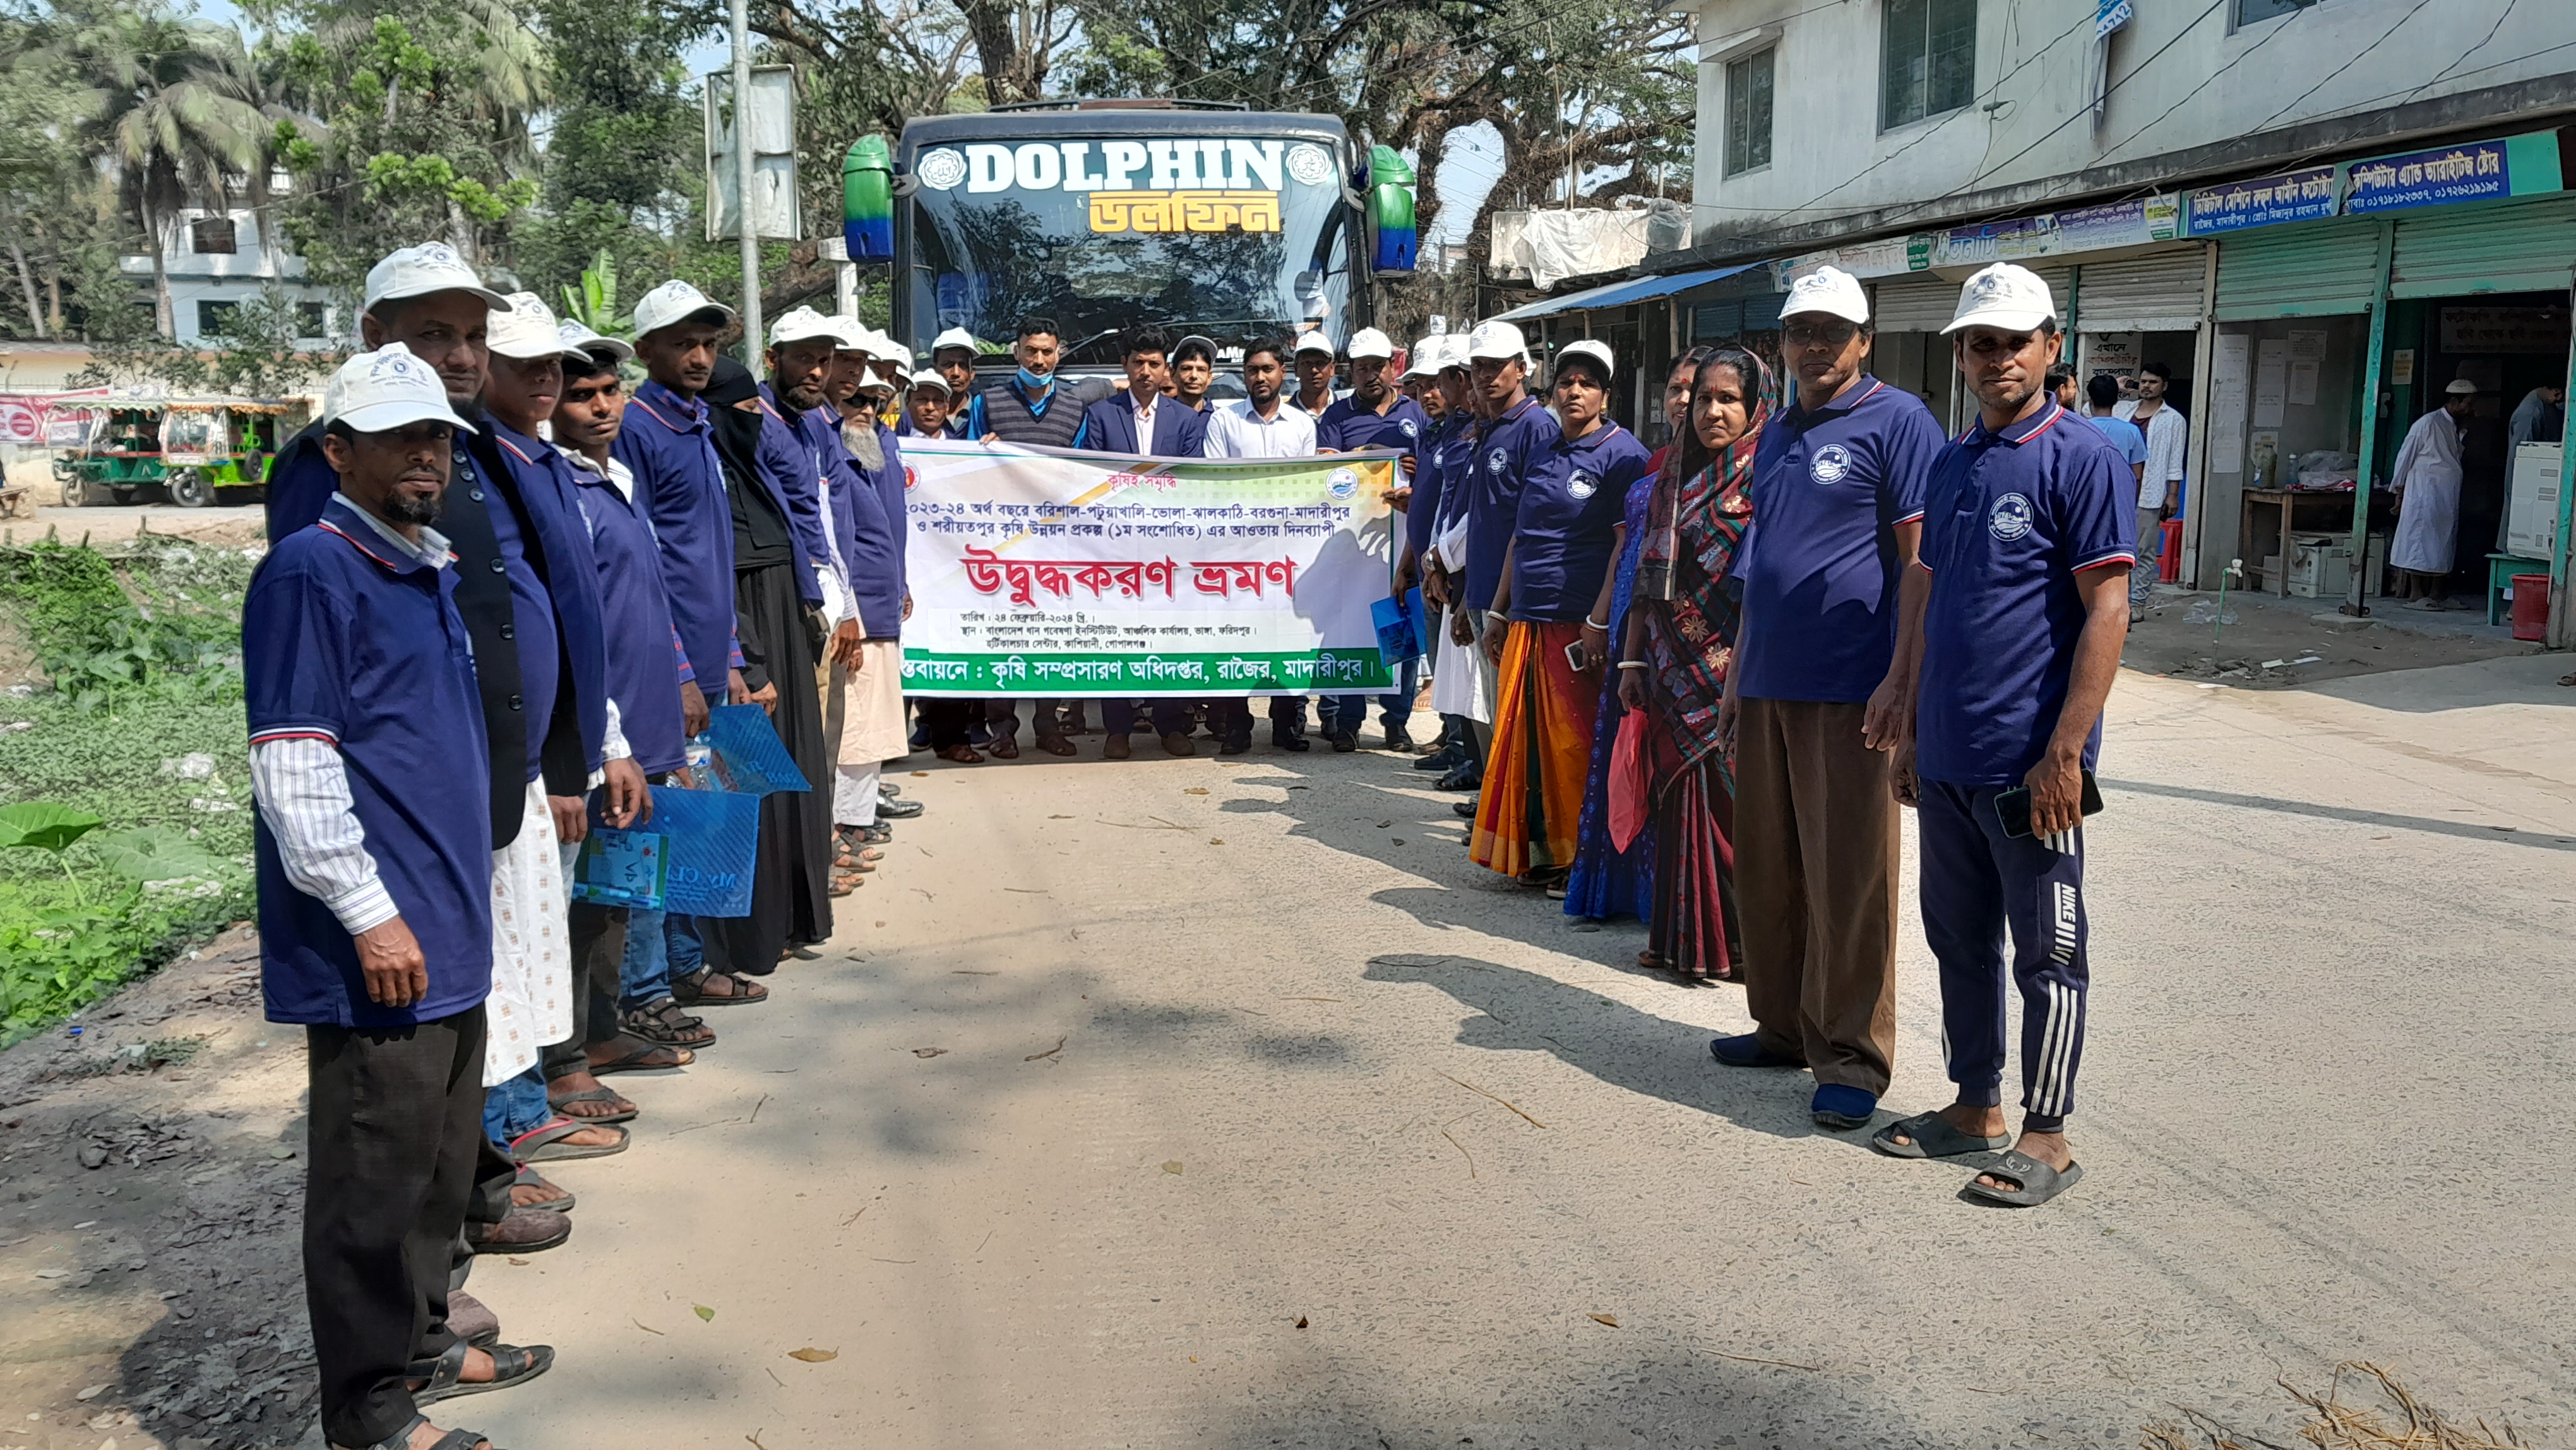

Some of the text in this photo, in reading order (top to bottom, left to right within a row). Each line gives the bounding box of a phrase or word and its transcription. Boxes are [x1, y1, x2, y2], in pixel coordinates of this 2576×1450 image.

[965, 140, 1284, 193] DOLPHIN
[997, 504, 1029, 518] বছরে
[1000, 519, 1023, 540] কৃষি
[1207, 525, 1225, 537] এর
[959, 544, 1296, 608] উদ্বুদ্ধকরণ ভ্রমণ
[989, 656, 1027, 689] কৃষি
[1032, 659, 1124, 682] সম্প্রসারণ
[1128, 655, 1210, 684] অধিদপ্তর,
[1215, 656, 1277, 683] রাজৈর,
[1282, 653, 1363, 682] মাদারীপুর
[2061, 884, 2075, 922] NIKE
